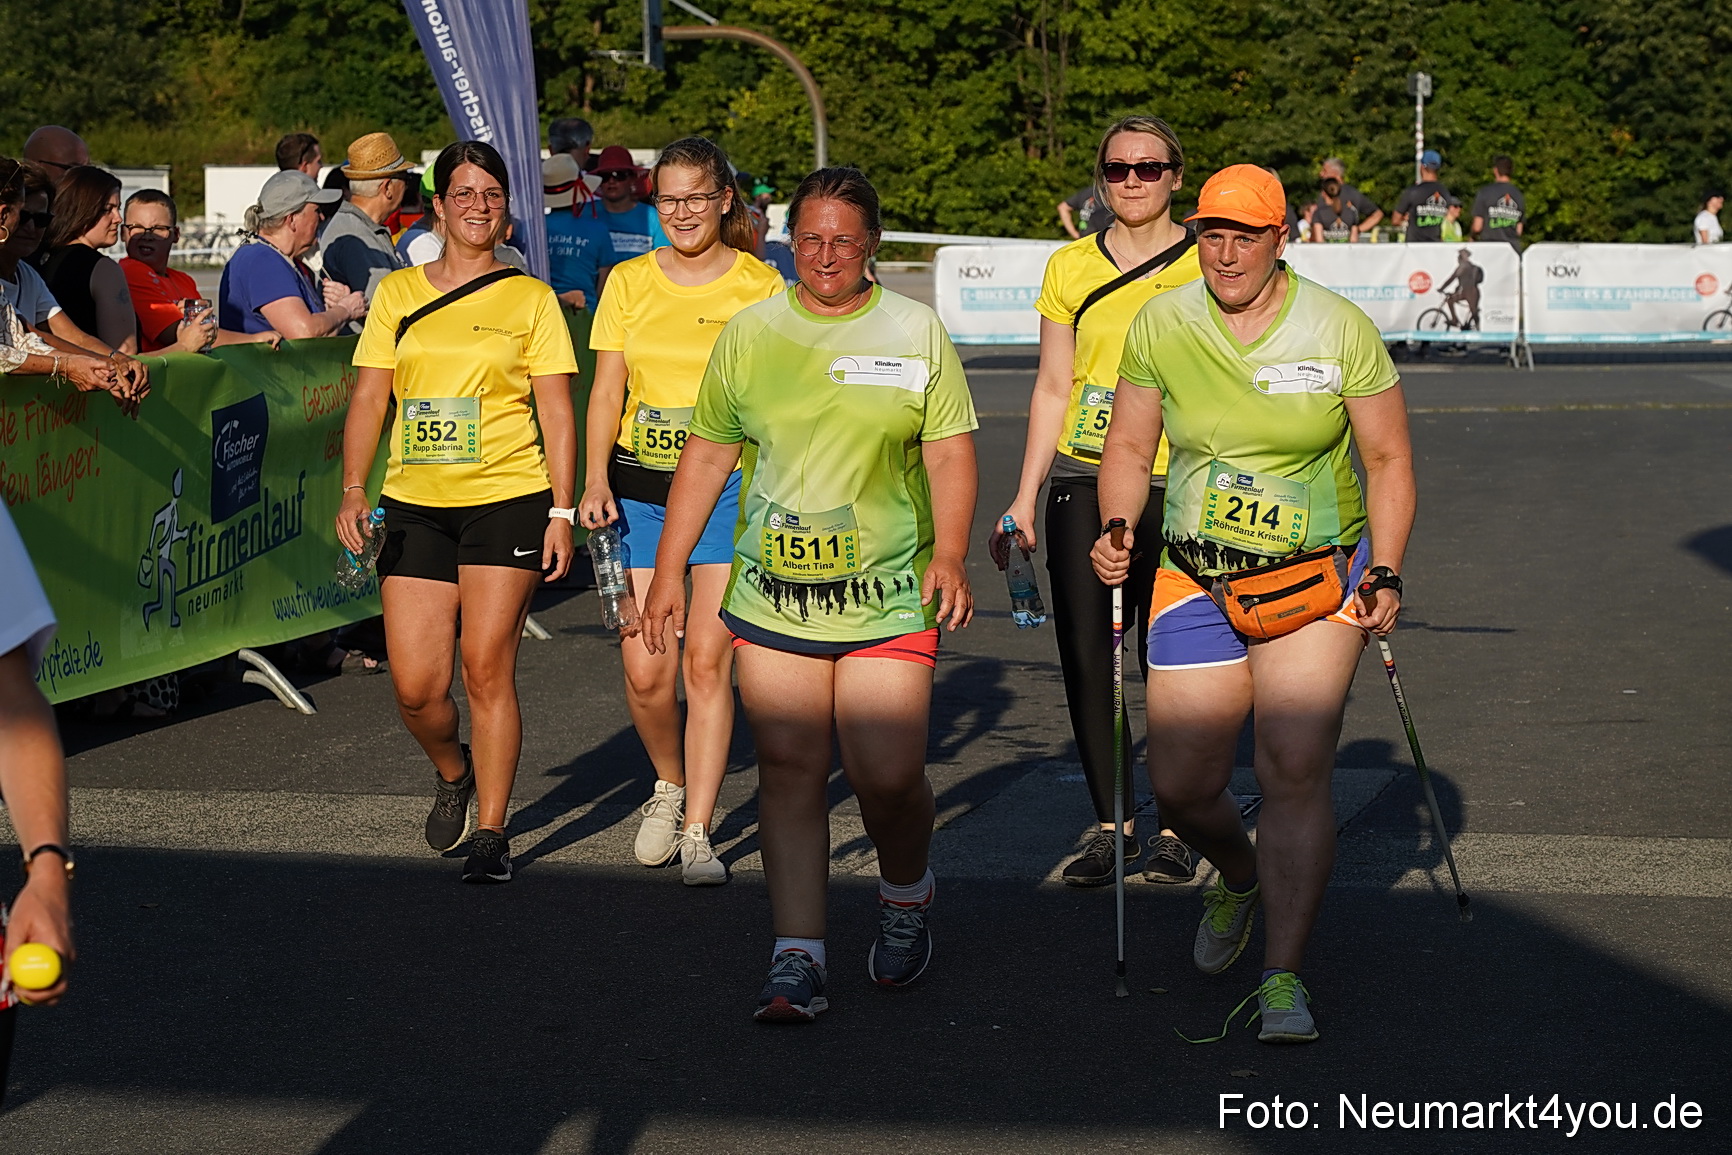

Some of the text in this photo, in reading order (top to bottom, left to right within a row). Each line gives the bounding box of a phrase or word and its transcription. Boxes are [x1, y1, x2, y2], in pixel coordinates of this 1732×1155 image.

[959, 267, 995, 278] NOW
[1546, 265, 1581, 277] NOW
[1549, 289, 1599, 300] E-BIKES
[874, 360, 902, 368] Klinikum
[1297, 365, 1324, 375] Klinikum
[24, 392, 88, 441] Firmen
[1074, 408, 1088, 439] WALK
[1093, 409, 1109, 430] 5
[416, 420, 458, 443] 552
[467, 423, 476, 453] 2022
[645, 428, 687, 450] 558
[223, 433, 260, 461] Fischer
[412, 443, 463, 453] Rupp Sabrina
[641, 448, 672, 459] Hausner
[36, 426, 101, 503] länger!
[1231, 483, 1265, 493] Firmenlauf
[1205, 492, 1218, 530] WALK
[1225, 496, 1280, 530] 214
[187, 469, 306, 587] firmenlauf
[781, 522, 812, 531] Firmenlauf
[1213, 519, 1289, 544] Röhrdanz Kristin
[1288, 513, 1303, 548] 2022
[765, 532, 773, 568] WALK
[774, 533, 839, 560] 1511
[845, 535, 856, 569] 2022
[782, 560, 835, 571] Albert Tina
[188, 570, 244, 617] neumarkt
[35, 630, 103, 694] rpfalz.de
